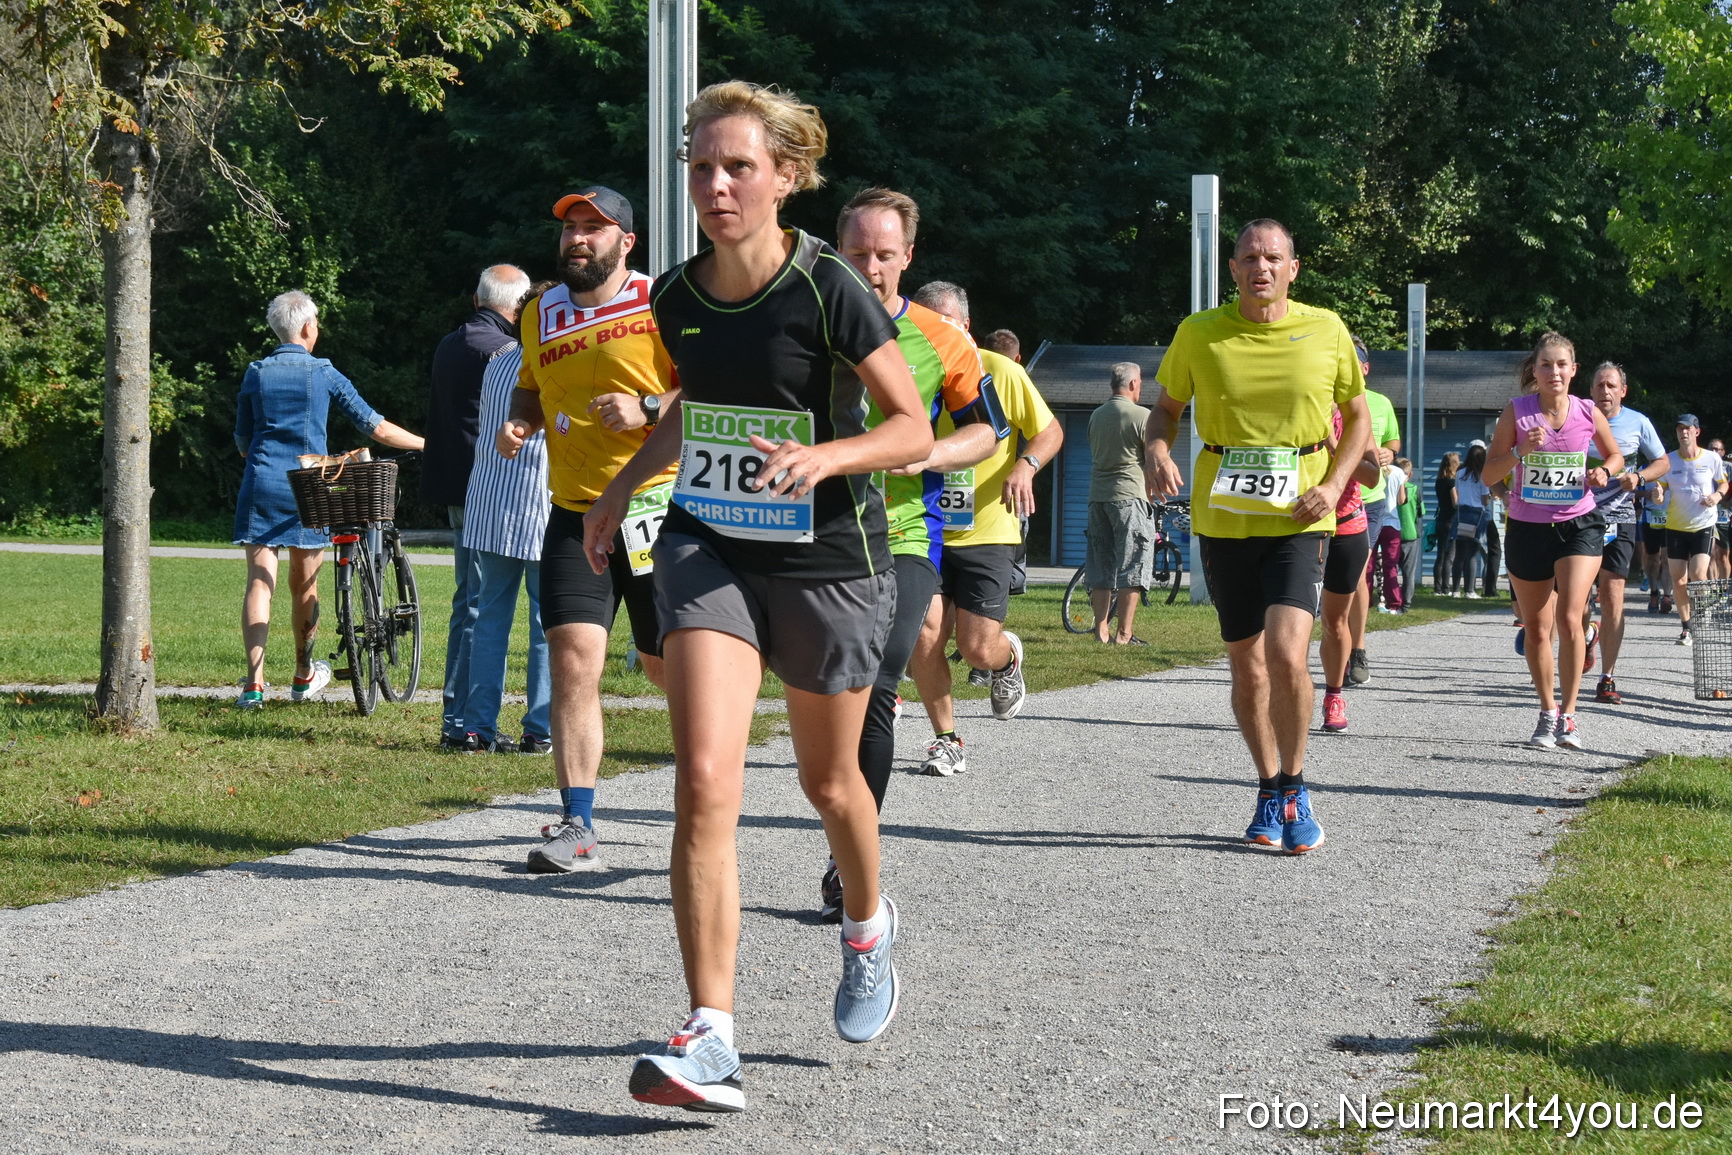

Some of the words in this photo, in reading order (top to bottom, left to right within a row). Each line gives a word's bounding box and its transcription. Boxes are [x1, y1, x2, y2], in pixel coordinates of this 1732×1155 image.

[540, 336, 588, 368] MAX
[691, 408, 800, 443] BOCK
[1227, 450, 1292, 468] BOCK
[1528, 453, 1581, 468] BOCK
[1228, 473, 1288, 498] 1397
[1529, 469, 1577, 487] 2424
[1532, 490, 1573, 499] RAMONA
[684, 501, 797, 526] CHRISTINE
